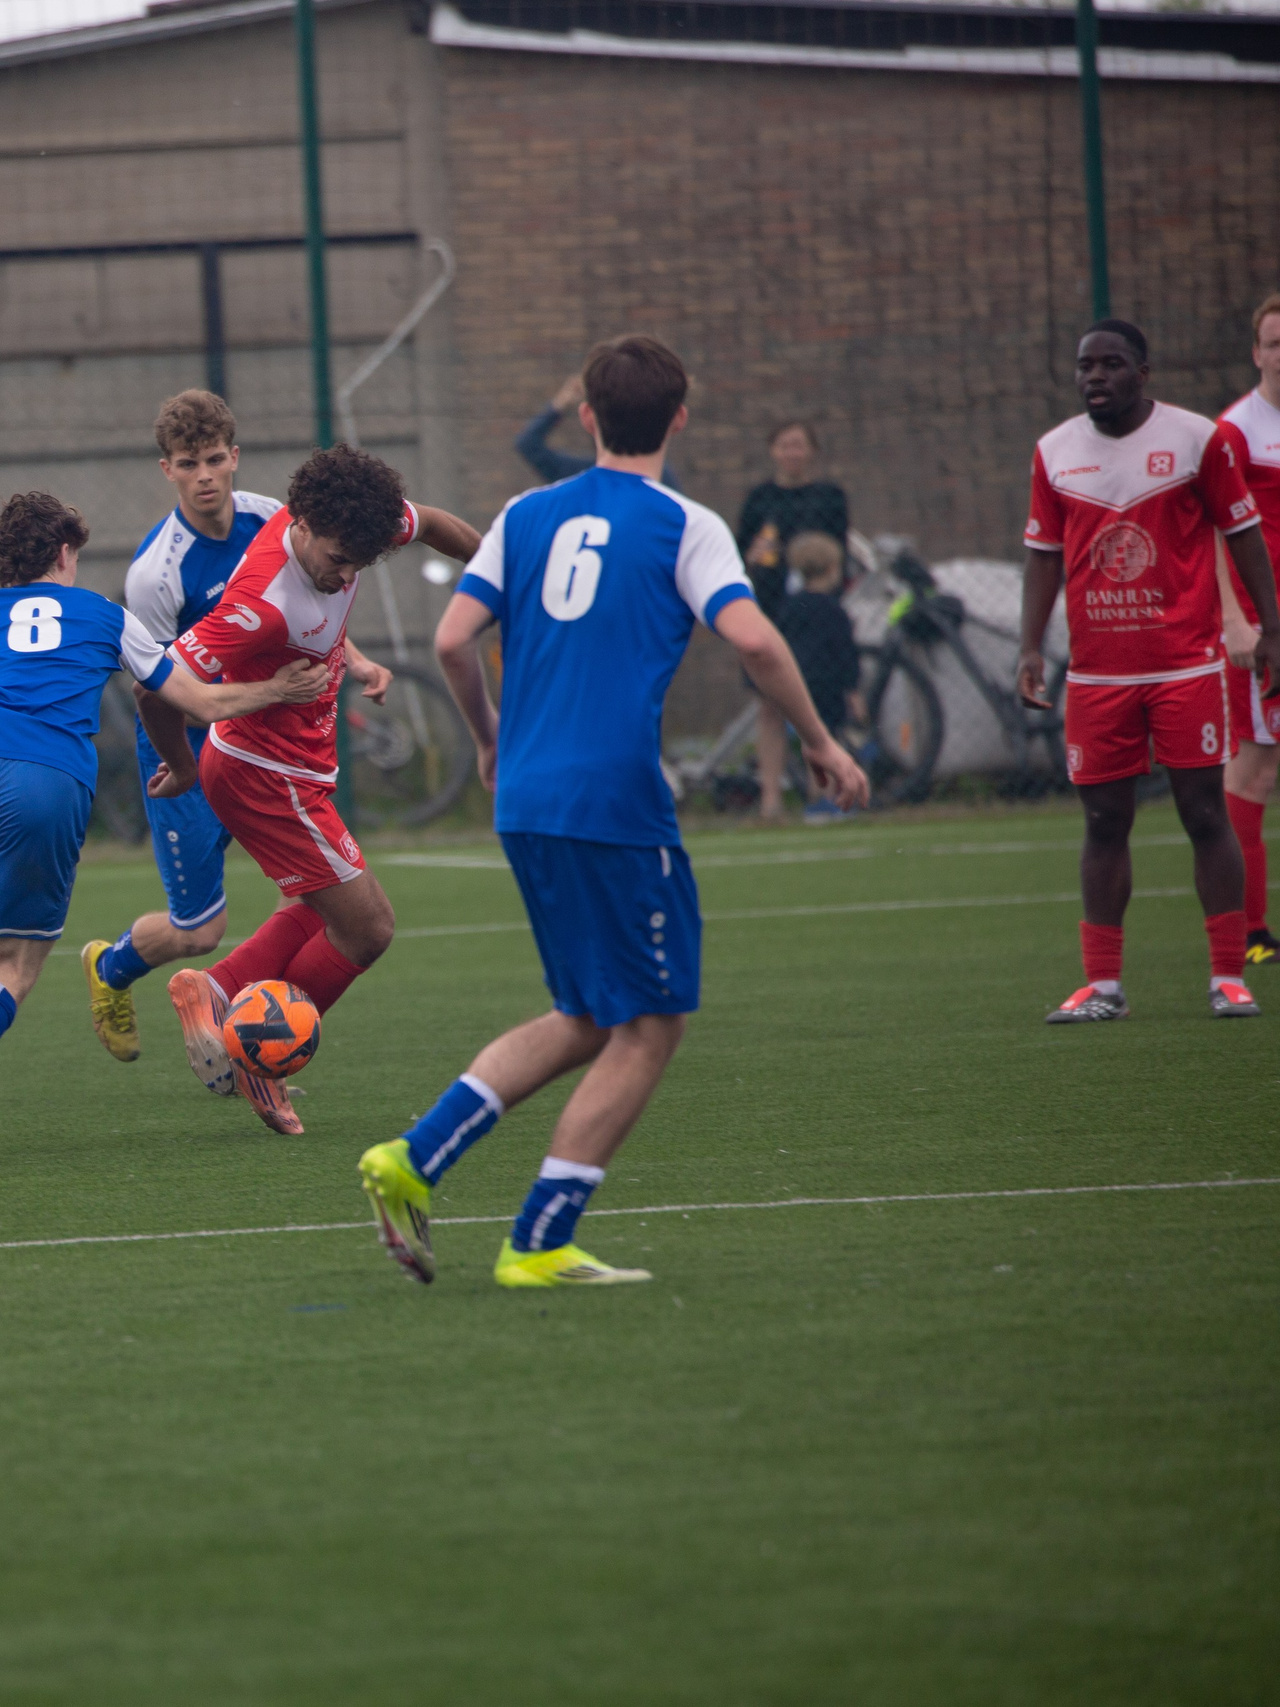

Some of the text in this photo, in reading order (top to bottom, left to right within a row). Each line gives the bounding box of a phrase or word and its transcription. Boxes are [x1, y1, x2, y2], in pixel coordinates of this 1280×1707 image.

[541, 514, 611, 622] 6
[7, 596, 63, 653] 8
[1201, 723, 1218, 755] 8
